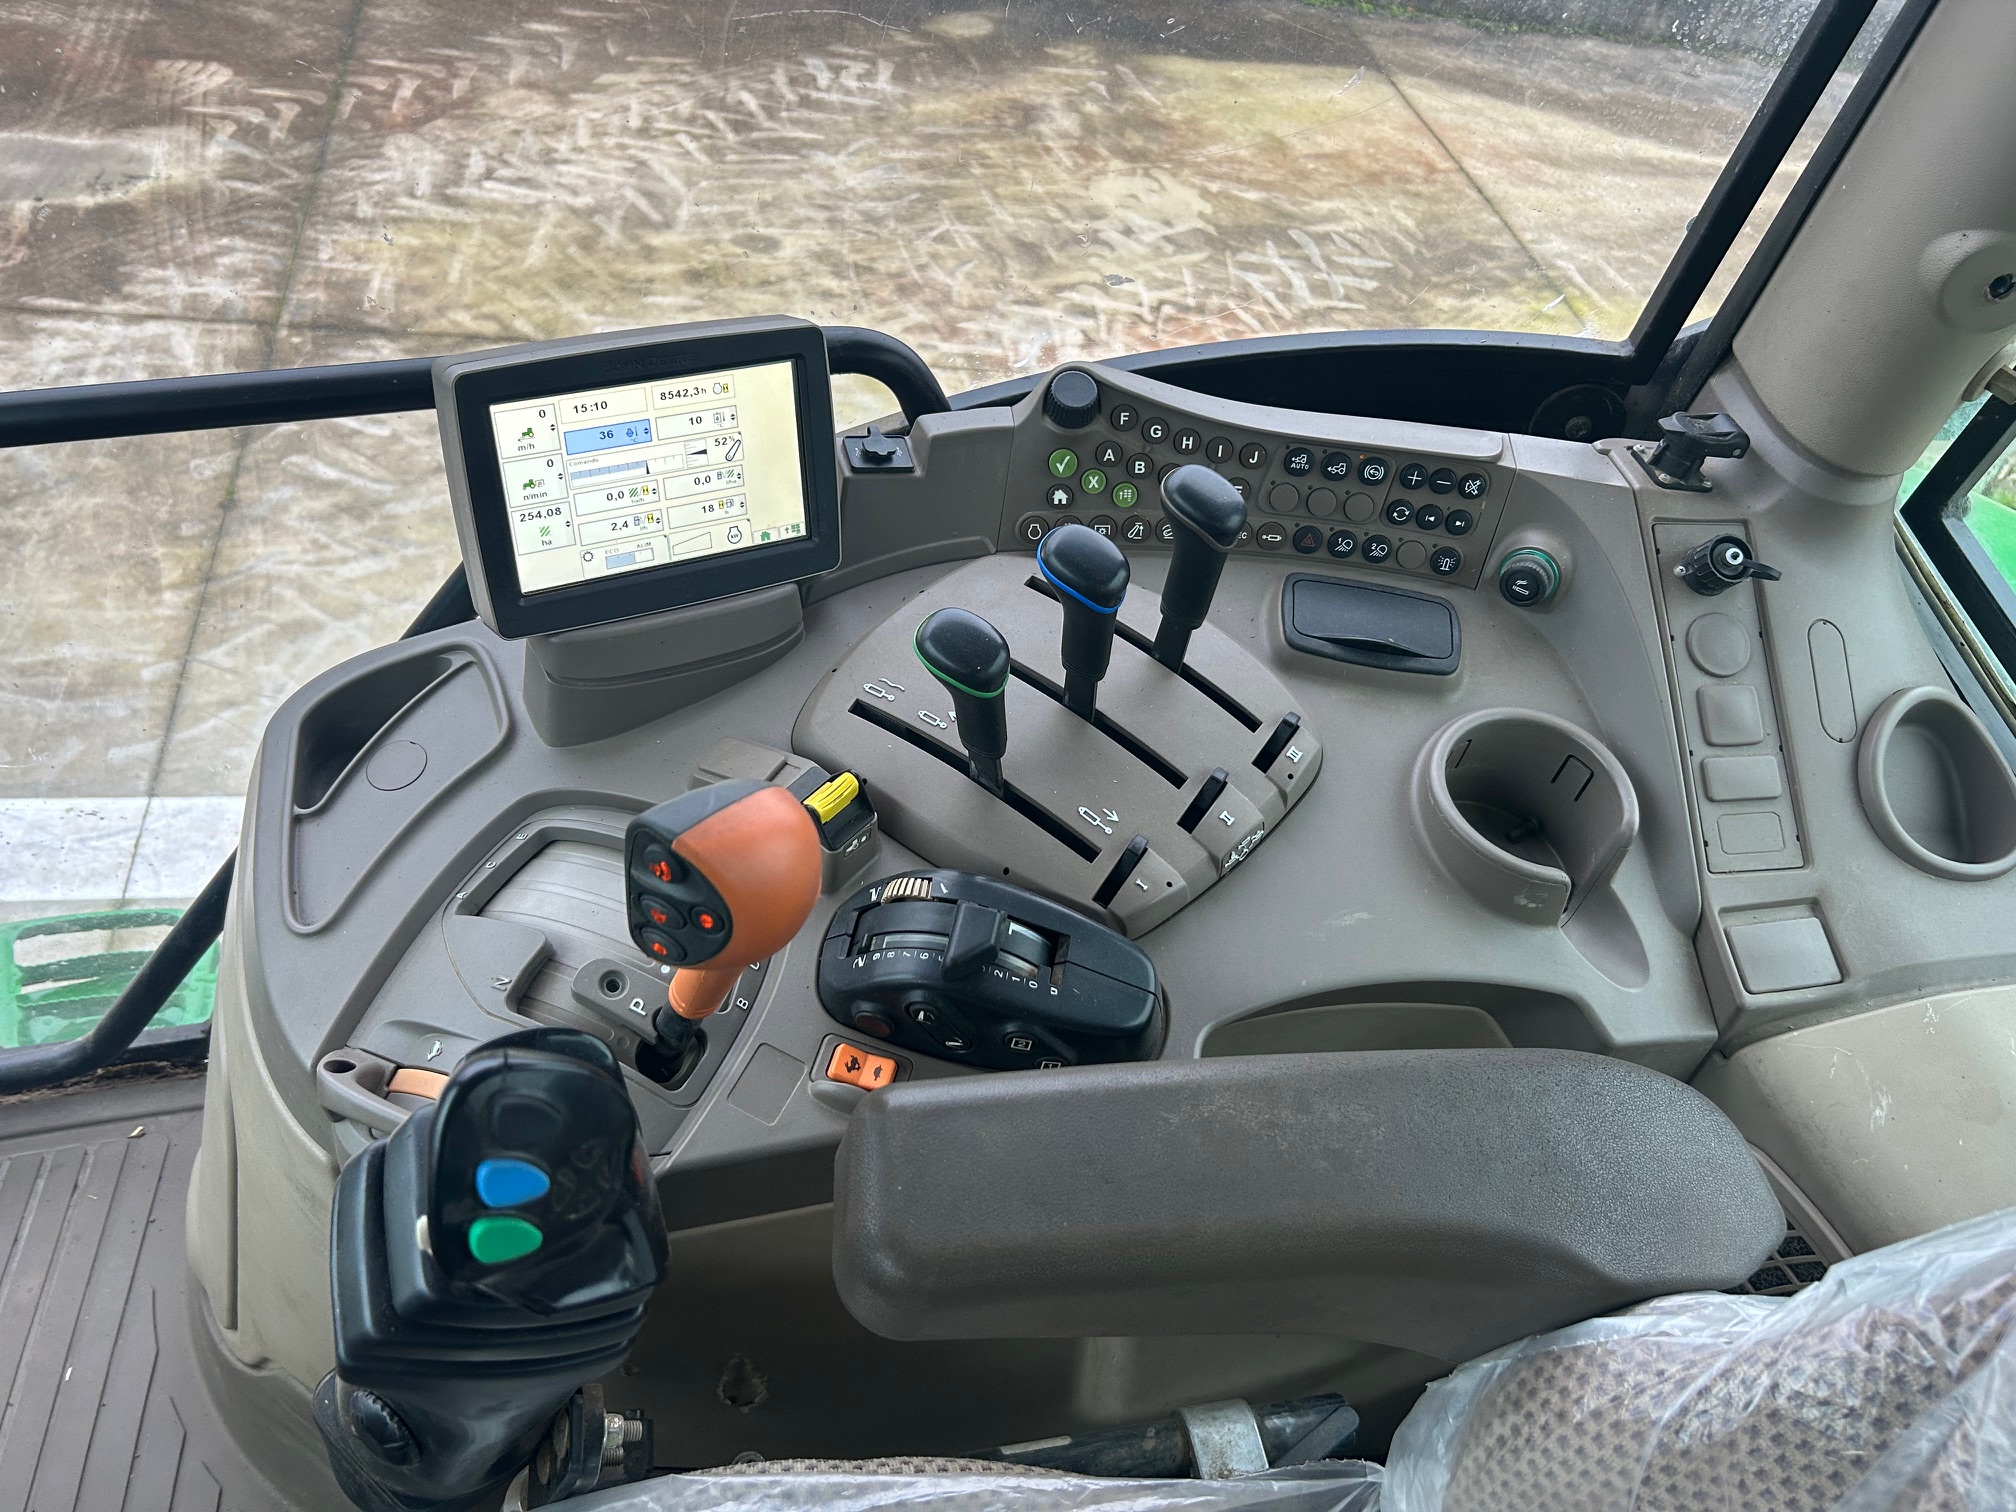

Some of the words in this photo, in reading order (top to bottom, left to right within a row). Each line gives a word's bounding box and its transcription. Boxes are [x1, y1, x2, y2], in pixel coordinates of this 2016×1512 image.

[573, 401, 608, 414] 15:10
[538, 409, 546, 418] 0
[689, 416, 703, 426] 10
[599, 430, 614, 440] 36
[1120, 412, 1130, 425] F
[1150, 425, 1162, 438] G
[1182, 437, 1193, 449] H
[1217, 445, 1223, 458] I
[1249, 451, 1259, 464] J
[517, 443, 535, 451] m/h
[547, 459, 554, 468] 0
[569, 458, 599, 467] Comando
[1103, 449, 1115, 462] A
[1135, 462, 1145, 474] B
[1290, 462, 1309, 470] AUTO
[694, 475, 711, 486] 0,0
[523, 491, 548, 501] n/min
[606, 491, 625, 502] 0,0
[702, 504, 715, 514] 18
[519, 507, 562, 523] 254,08
[611, 521, 629, 531] 2,4
[542, 539, 552, 547] ha
[1371, 542, 1377, 550] 2
[456, 891, 467, 899] A
[872, 953, 880, 961] 9
[920, 952, 929, 960] 6
[993, 969, 1004, 978] 2
[1028, 980, 1038, 989] 0
[492, 975, 512, 992] N
[629, 998, 647, 1016] P
[736, 997, 749, 1010] B
[1018, 1040, 1026, 1048] 2
